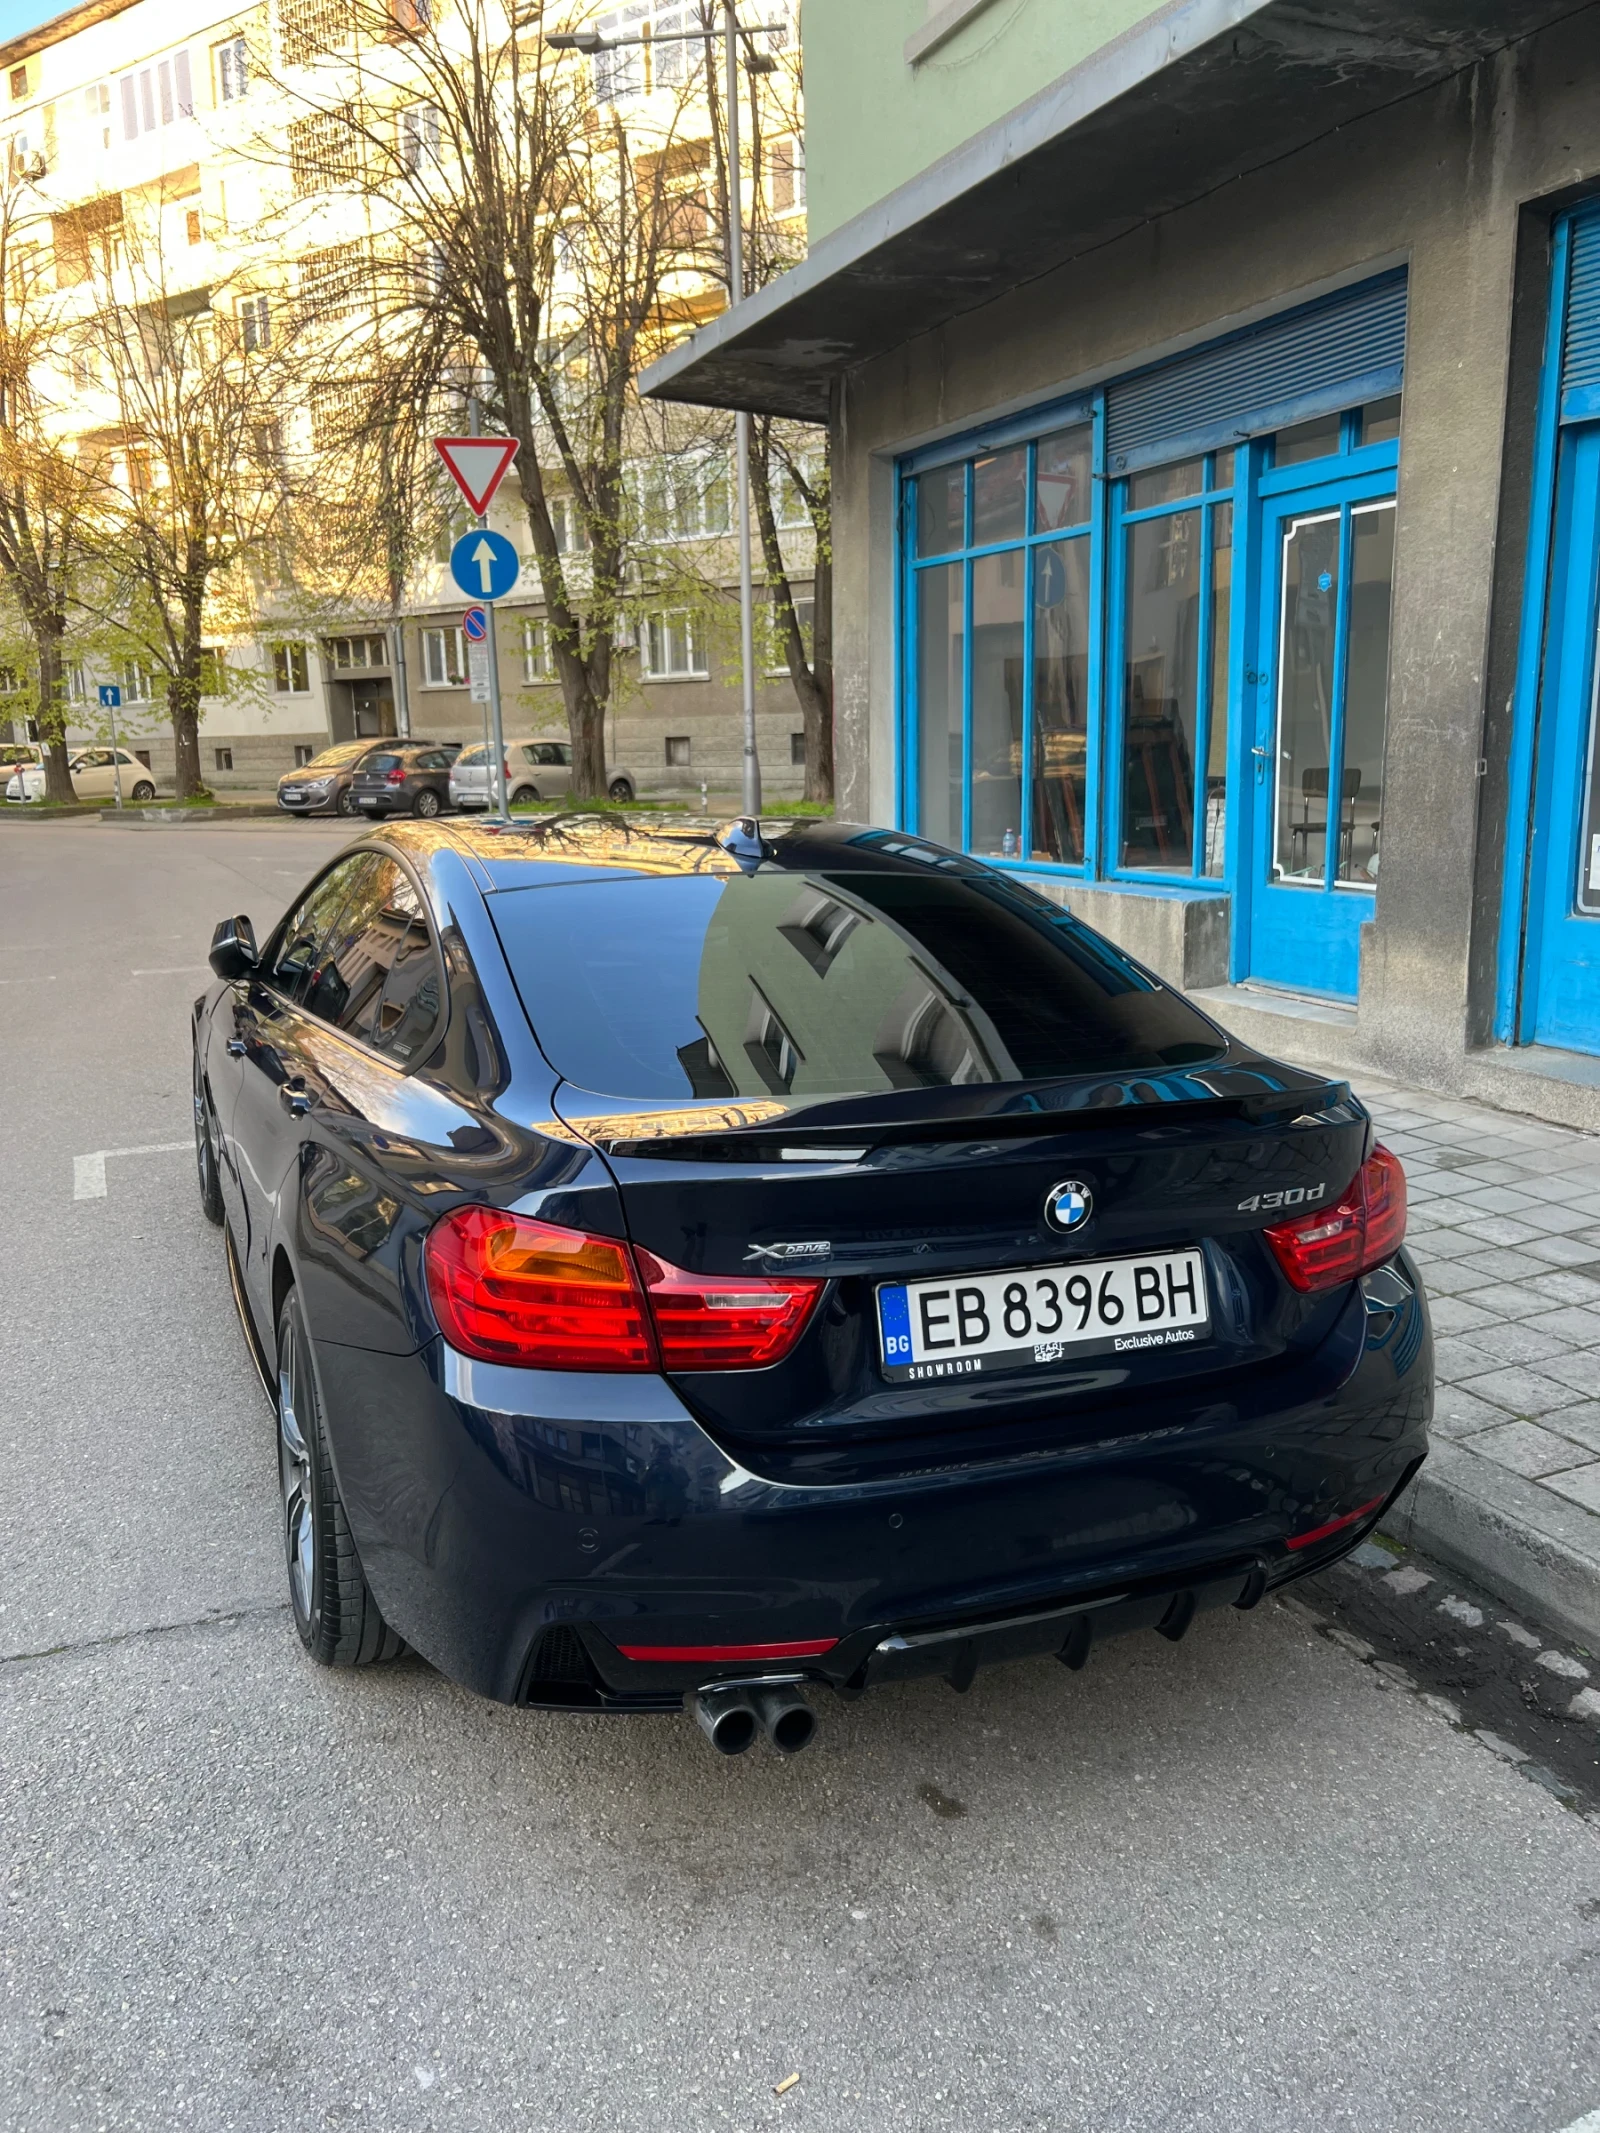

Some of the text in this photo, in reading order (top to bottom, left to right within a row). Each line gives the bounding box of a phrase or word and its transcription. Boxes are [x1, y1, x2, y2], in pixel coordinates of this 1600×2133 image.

[1051, 1183, 1091, 1201] BMW
[1237, 1182, 1325, 1211] 430d
[918, 1260, 1197, 1351] EB 8396 BH
[886, 1335, 910, 1354] BG
[1033, 1342, 1065, 1354] PEARL
[1114, 1330, 1195, 1351] Exclusive Autos
[908, 1358, 982, 1380] SHOWROOM
